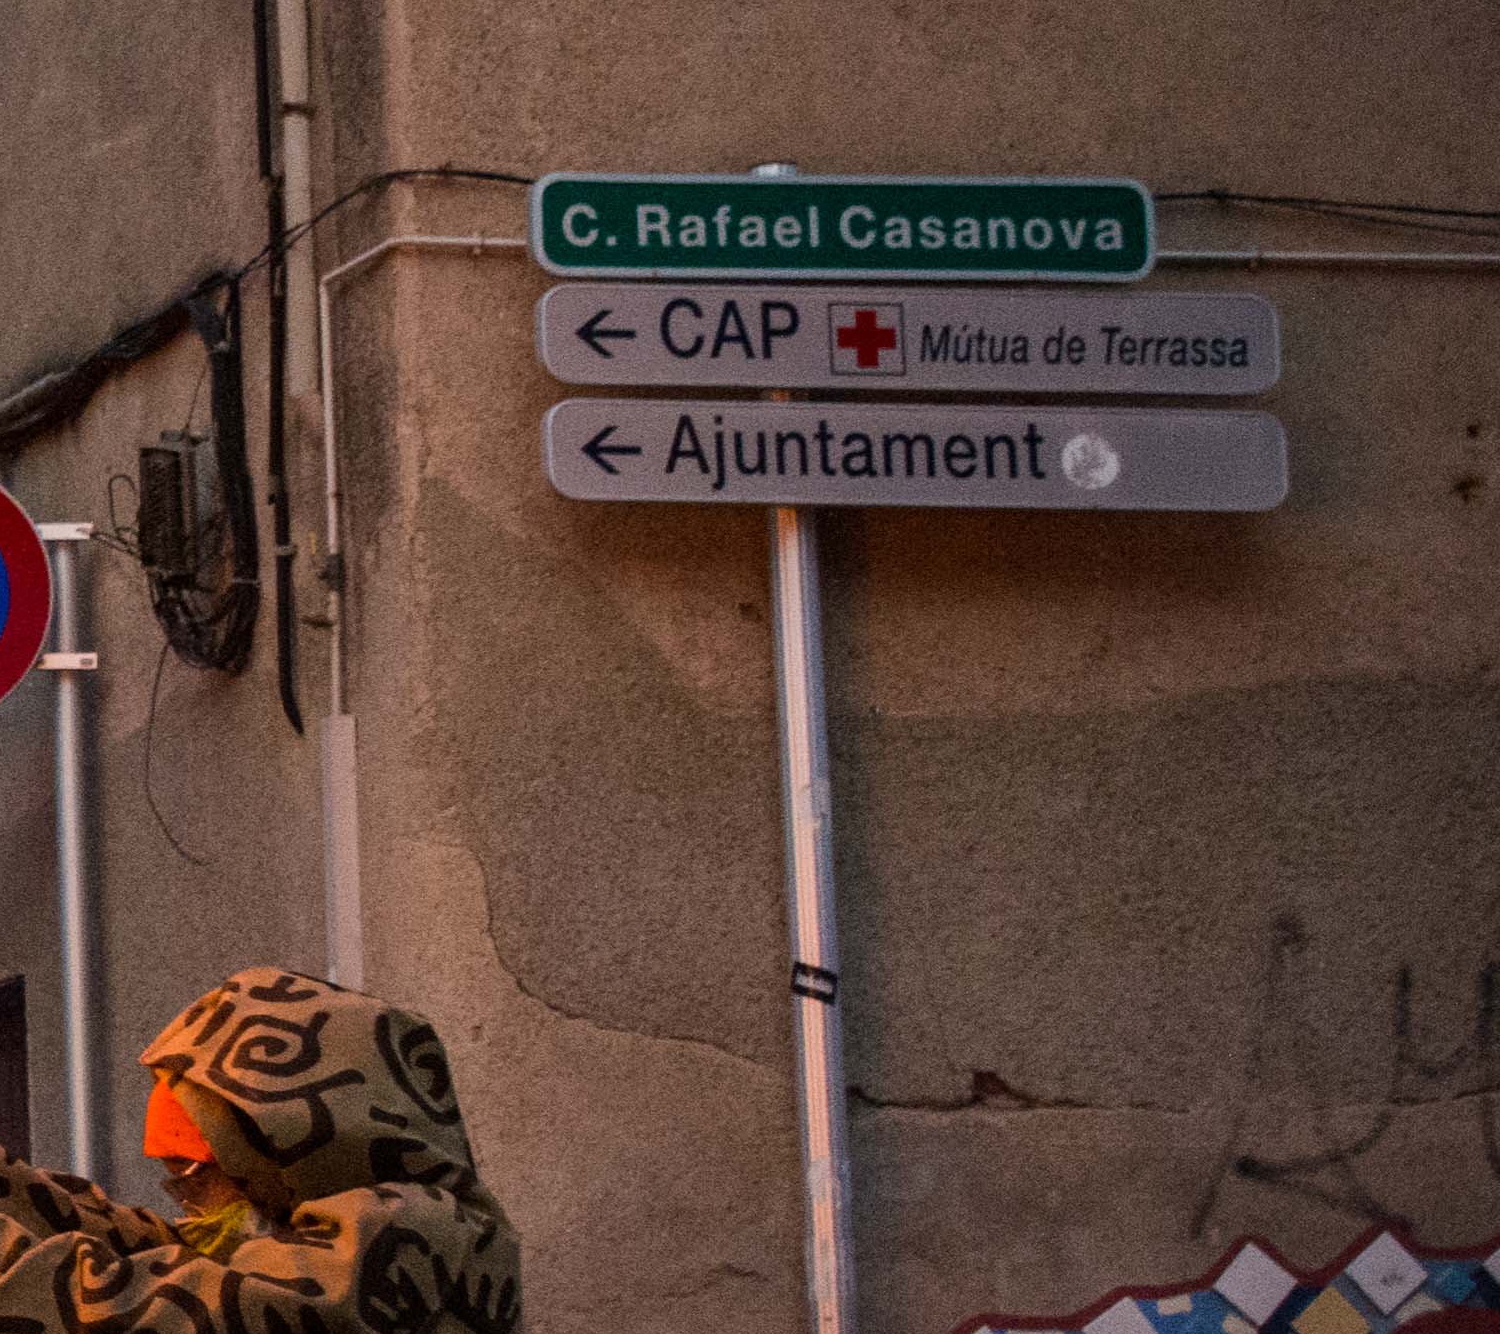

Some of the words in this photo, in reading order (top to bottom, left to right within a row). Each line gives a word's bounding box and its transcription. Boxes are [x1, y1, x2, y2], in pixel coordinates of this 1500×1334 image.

[562, 203, 618, 247] C.
[636, 204, 820, 247] Rafael
[839, 205, 1124, 250] Casanova
[659, 298, 800, 359] CAP
[920, 325, 1029, 364] Mútua
[1042, 327, 1087, 365] de
[1101, 327, 1250, 367] Terrassa
[665, 414, 1046, 490] Ajuntament
